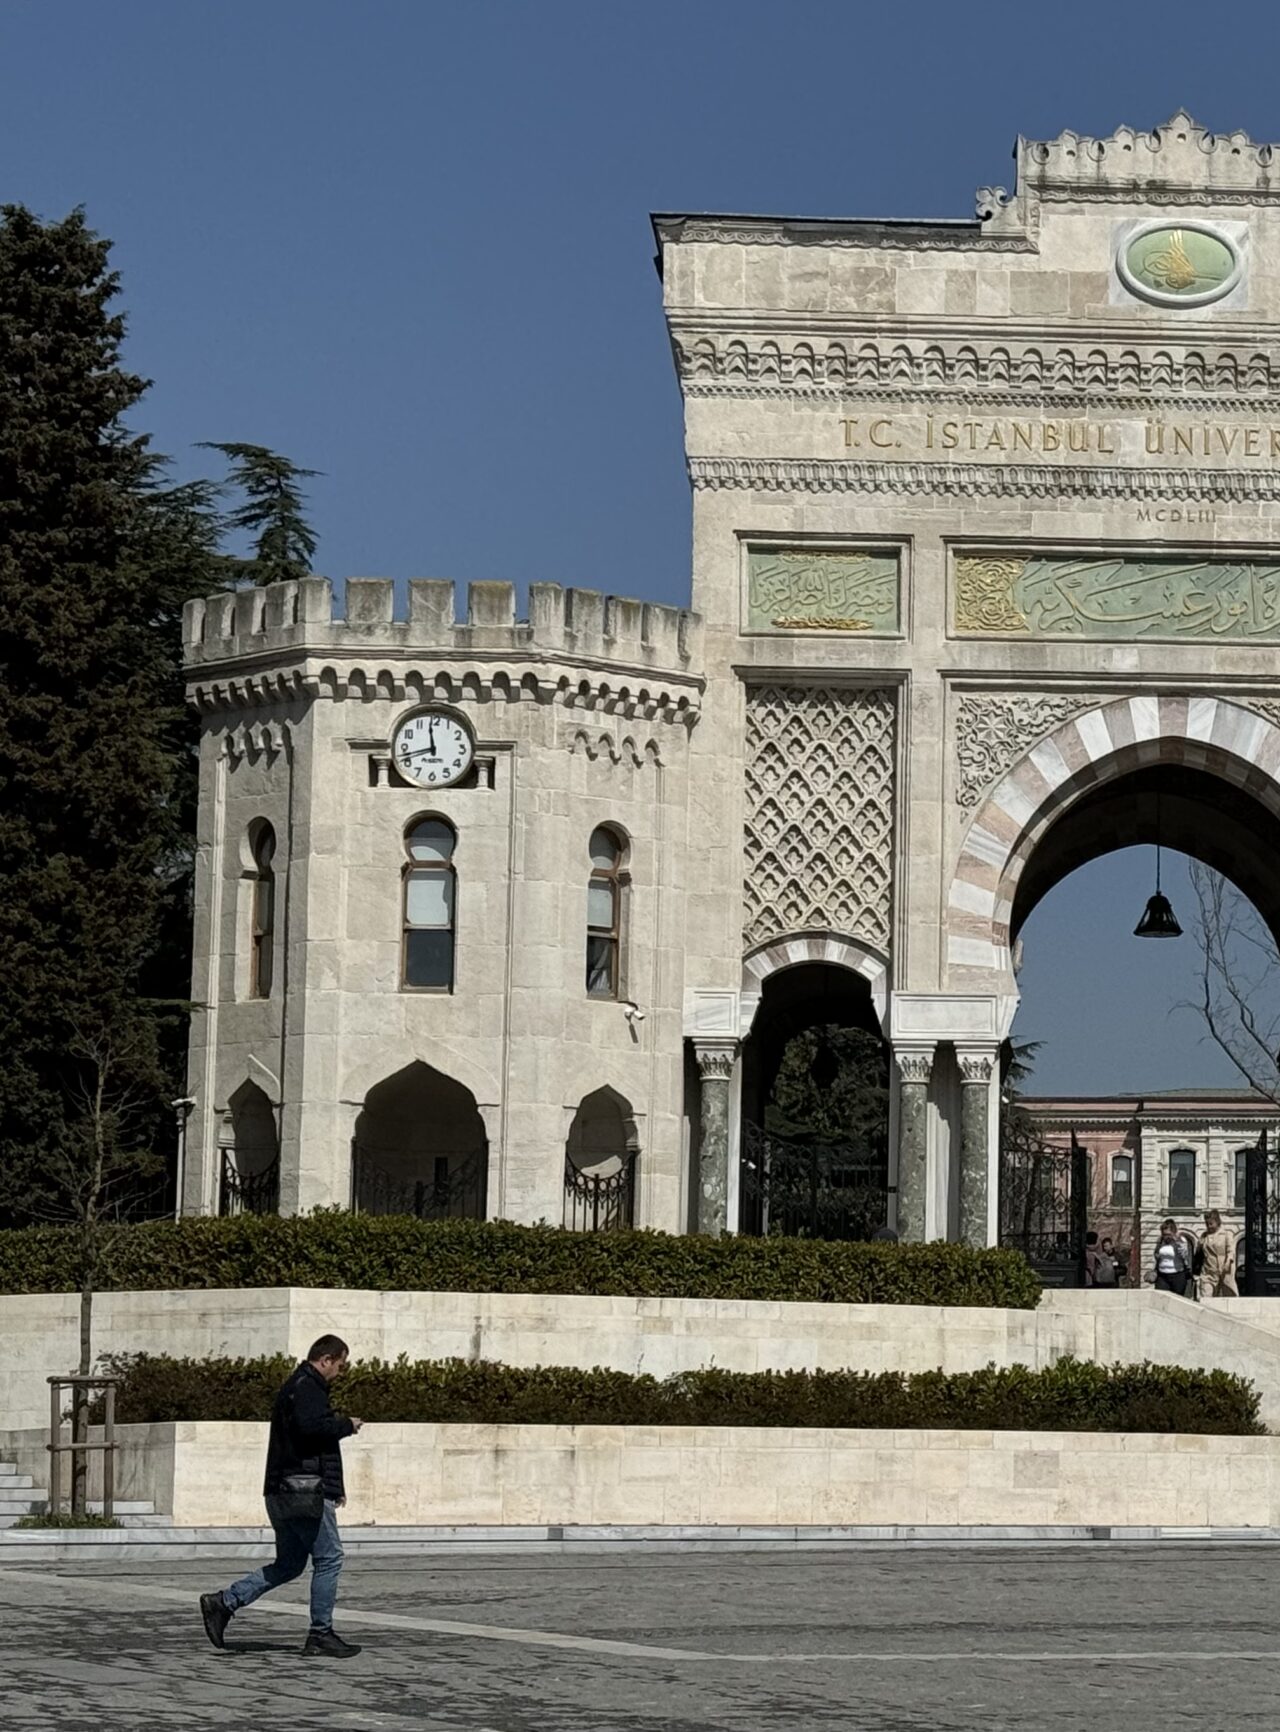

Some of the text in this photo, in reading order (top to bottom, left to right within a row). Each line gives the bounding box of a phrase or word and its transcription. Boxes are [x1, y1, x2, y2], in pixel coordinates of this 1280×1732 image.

[926, 413, 1114, 453] İSTANBUL
[1136, 508, 1217, 523] MCDLIII
[416, 719, 423, 730] 11
[404, 729, 413, 739] 10
[454, 730, 462, 741] 2
[400, 743, 408, 753] 9
[458, 743, 466, 755] 3
[452, 758, 462, 768] 4
[414, 767, 422, 777] 7
[428, 771, 436, 781] 6
[442, 768, 451, 779] 5
